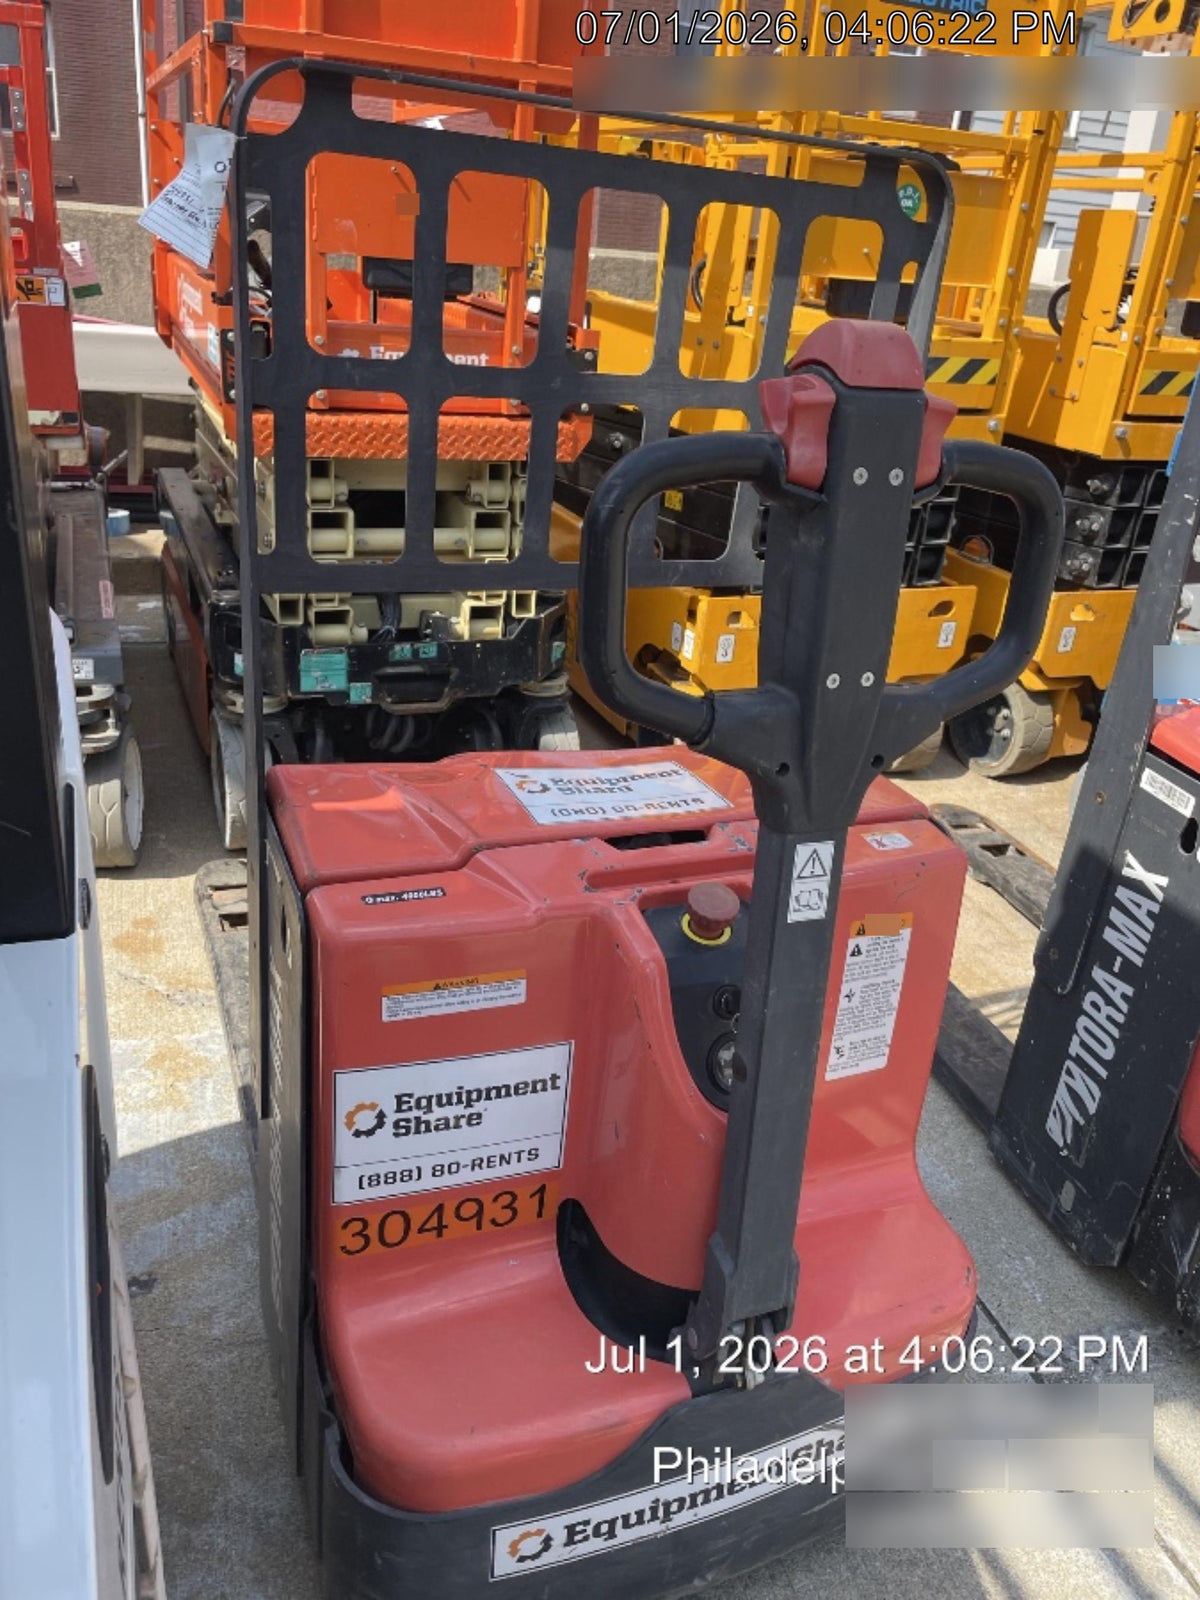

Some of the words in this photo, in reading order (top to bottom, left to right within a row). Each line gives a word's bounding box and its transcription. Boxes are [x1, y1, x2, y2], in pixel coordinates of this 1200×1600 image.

[1068, 849, 1169, 1080] TORA-MAX
[393, 1073, 561, 1115] Equipment
[392, 1109, 484, 1138] Share
[358, 1166, 423, 1190] (888)
[431, 1147, 540, 1179] 80-RENTS
[339, 1183, 548, 1256] 304931
